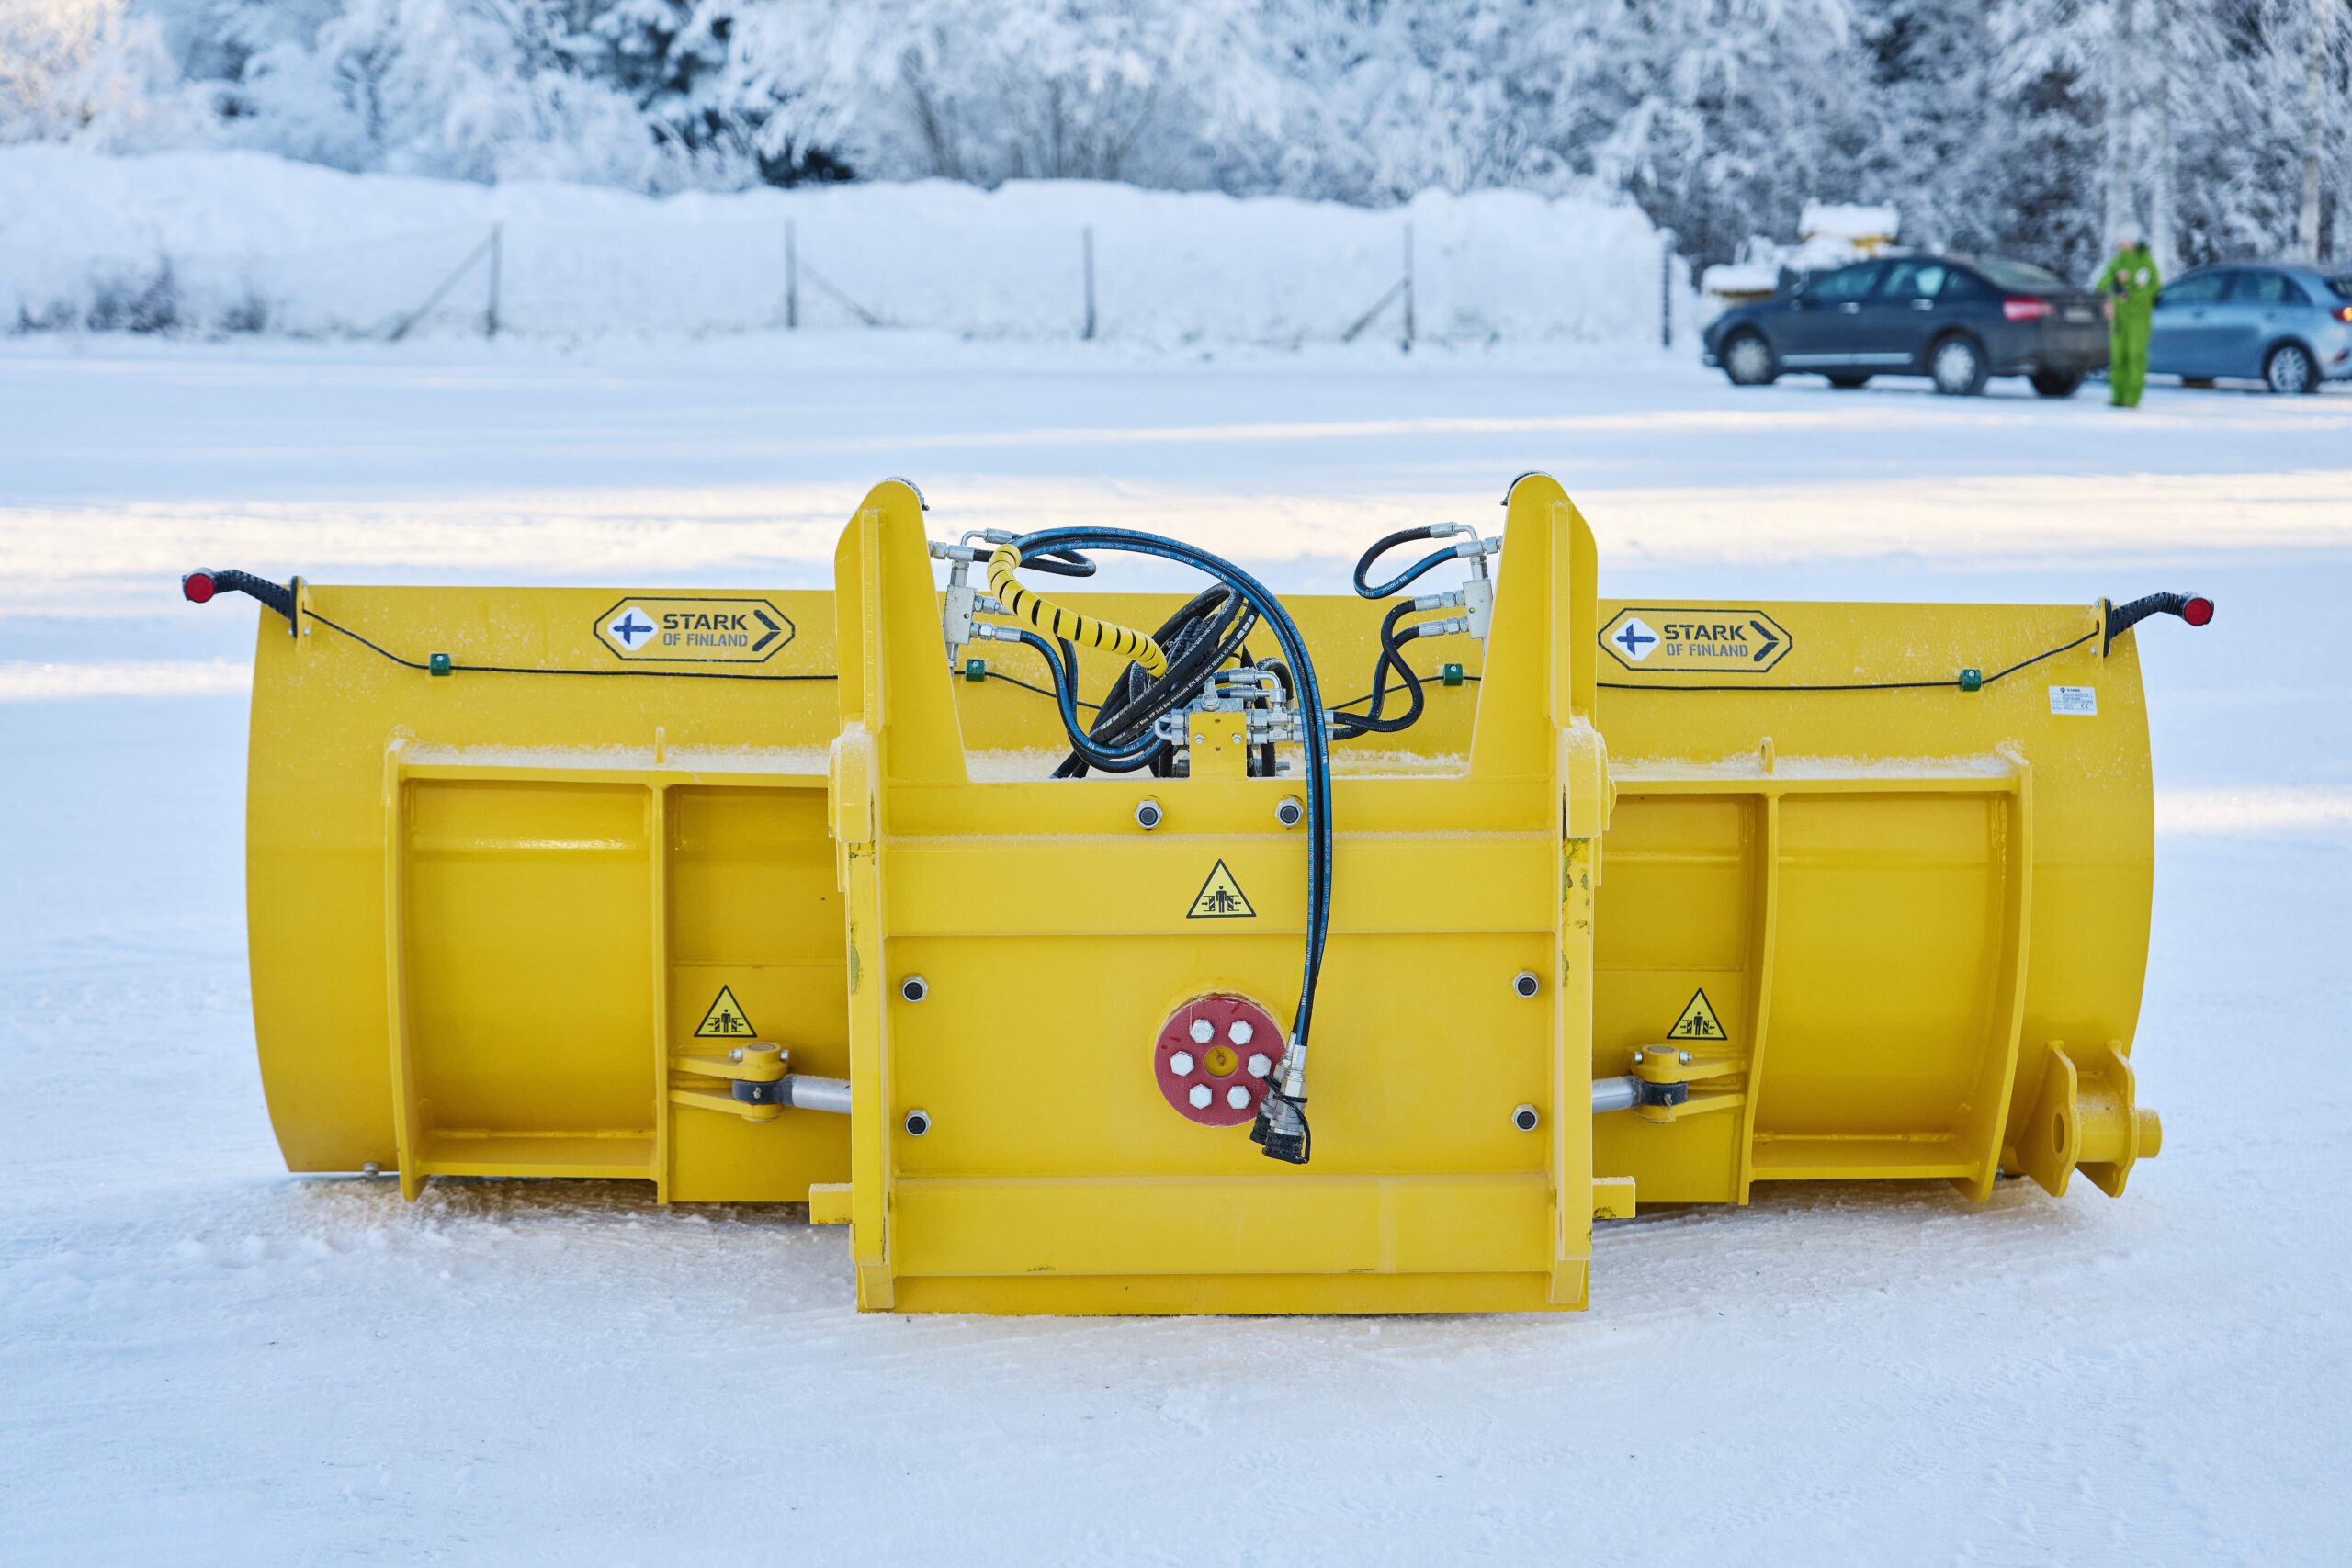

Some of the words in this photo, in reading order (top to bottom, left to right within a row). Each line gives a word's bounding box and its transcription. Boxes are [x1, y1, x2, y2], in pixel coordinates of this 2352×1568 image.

[663, 614, 748, 630] STARK
[663, 633, 681, 645] OF
[687, 633, 748, 647] FINLAND
[1664, 624, 1747, 641] STARK
[1666, 643, 1683, 655] OF
[1690, 644, 1748, 657] FINLAND
[1161, 699, 1172, 709] Bar
[1170, 685, 1190, 703] exceeds
[1187, 679, 1196, 688] EN
[1193, 672, 1204, 682] 857
